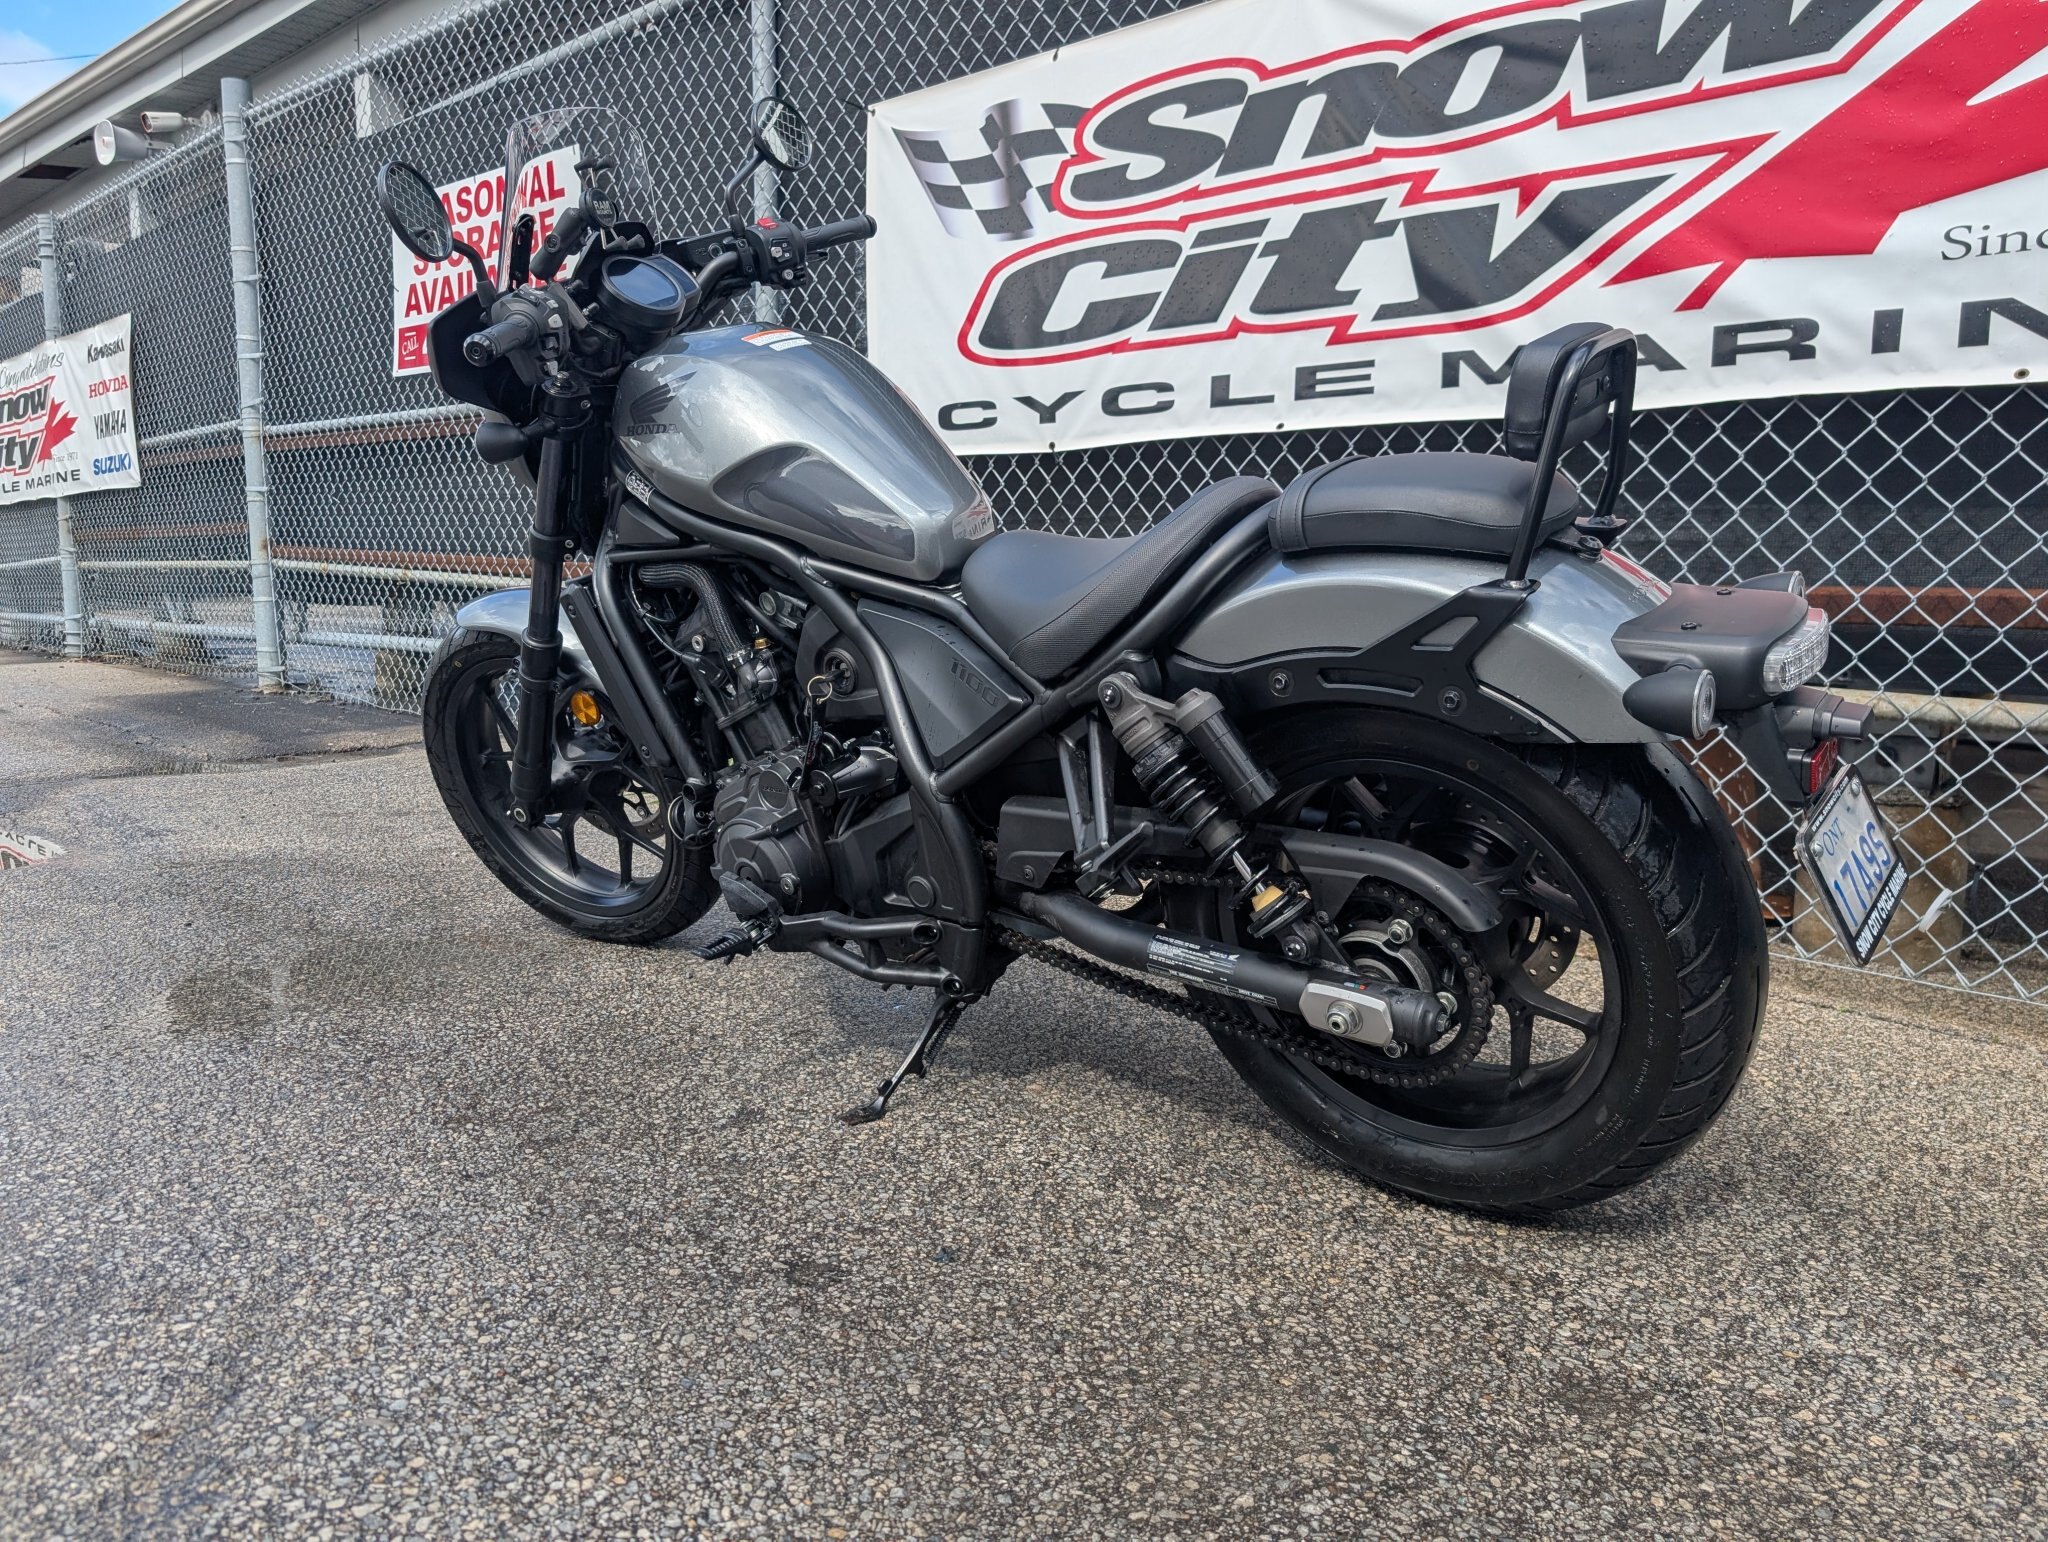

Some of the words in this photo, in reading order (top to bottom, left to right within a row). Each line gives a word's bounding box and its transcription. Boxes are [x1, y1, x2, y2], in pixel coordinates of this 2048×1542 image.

[1070, 0, 1888, 202] Snow
[593, 200, 611, 210] RAM
[981, 172, 1678, 351] City
[87, 335, 125, 364] Kawasaki
[401, 335, 420, 355] CALL
[938, 359, 1376, 431] CYCLE
[93, 409, 127, 440] YAMAHA
[626, 423, 679, 436] HONDA
[25, 468, 81, 491] MARINE
[92, 452, 132, 477] SUZUKI
[951, 657, 998, 707] 1100
[1855, 924, 1874, 958] SNOW
[1868, 907, 1883, 937] CITY
[1876, 886, 1895, 919] CYCLE
[1888, 862, 1908, 898] MARINE
